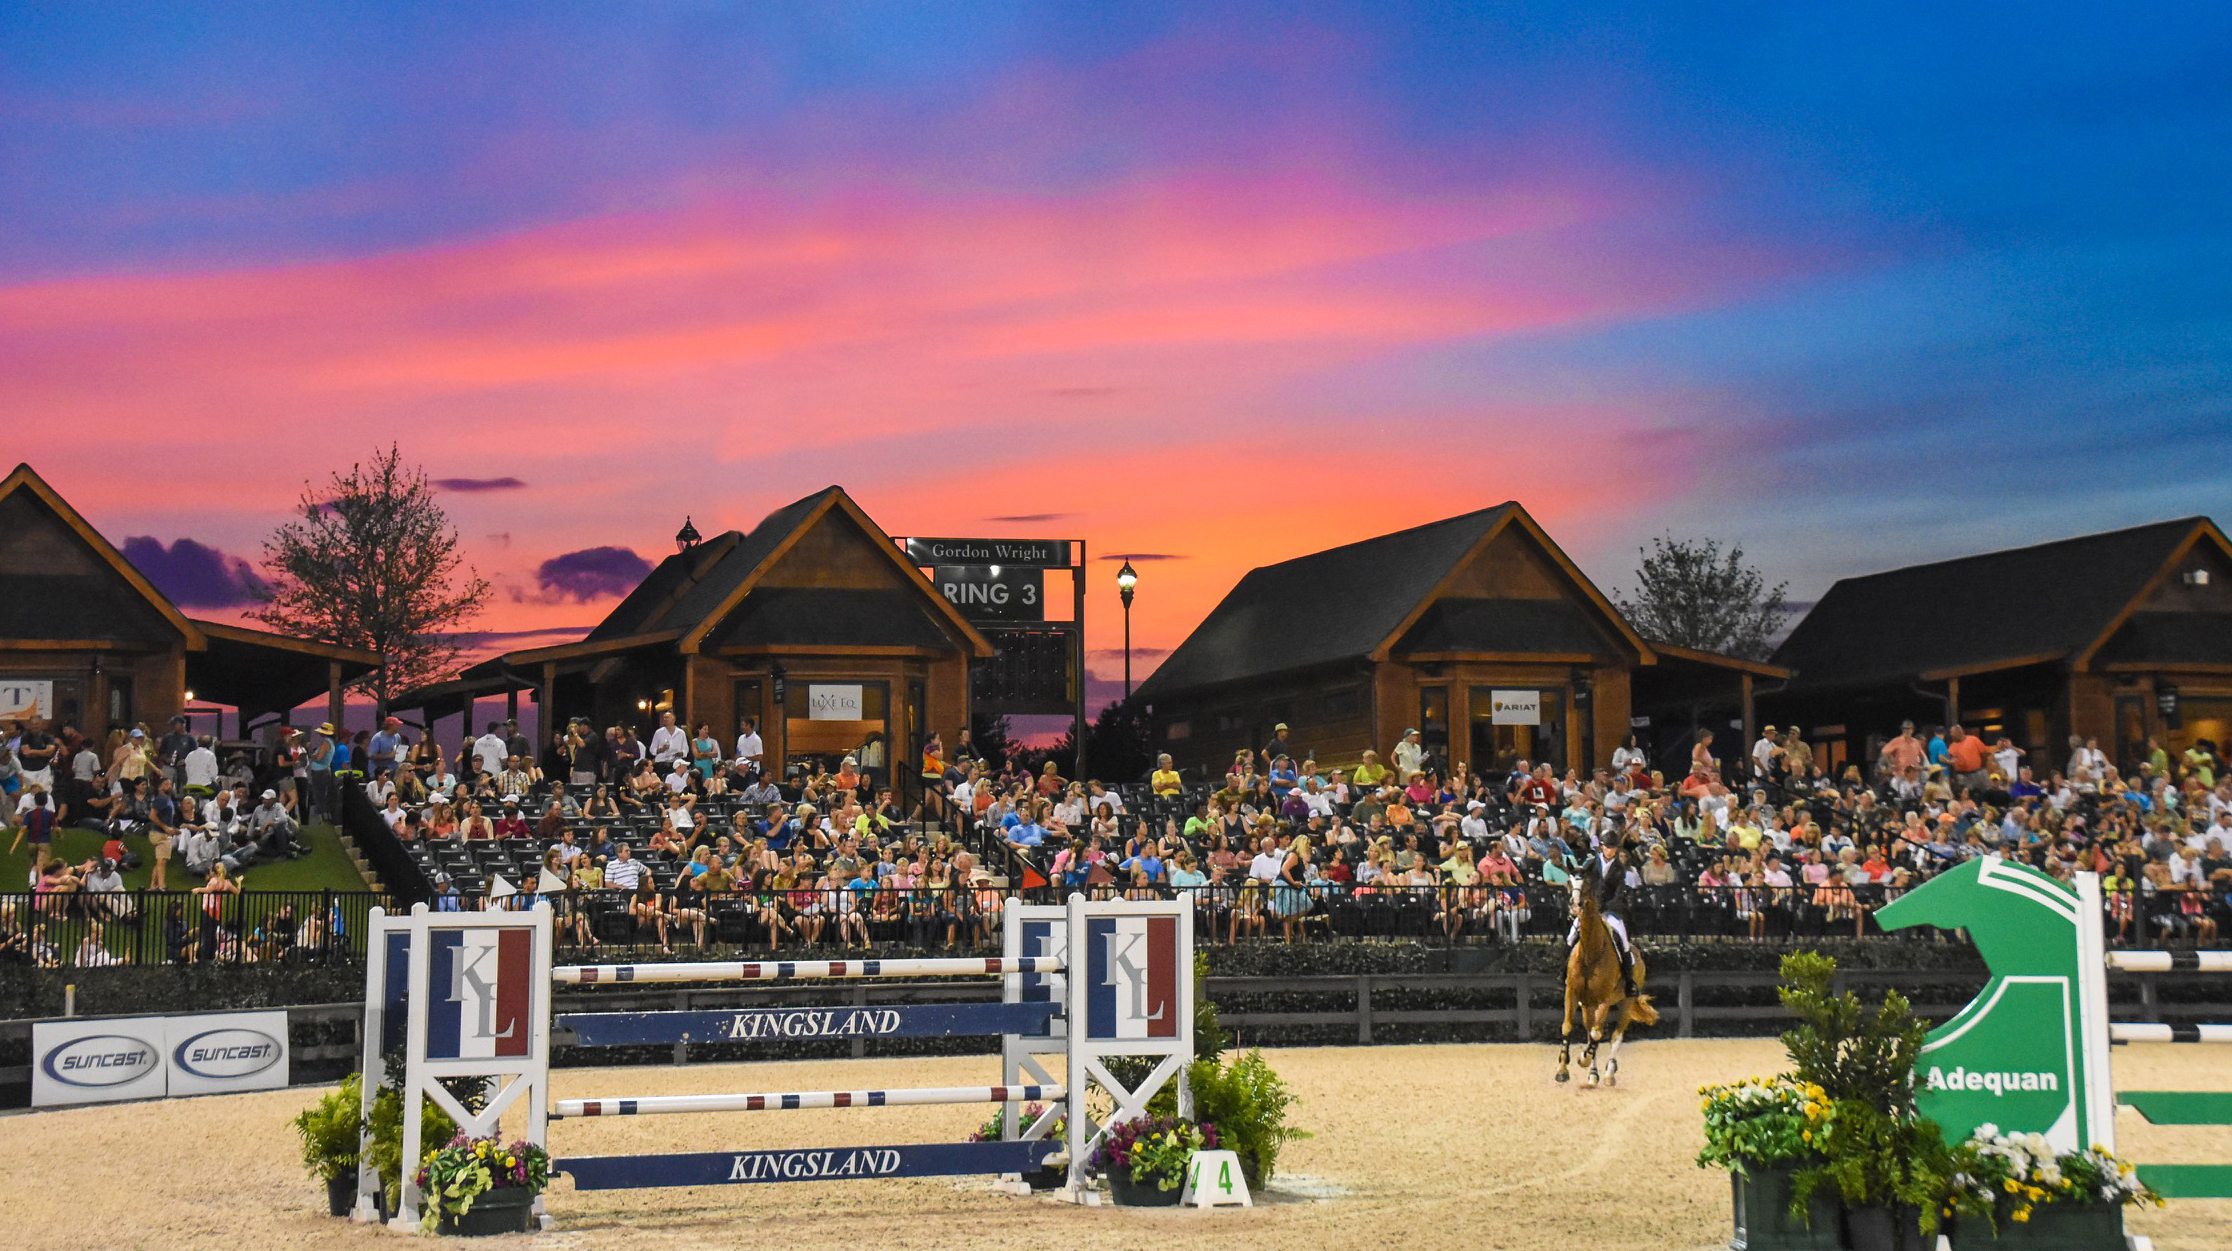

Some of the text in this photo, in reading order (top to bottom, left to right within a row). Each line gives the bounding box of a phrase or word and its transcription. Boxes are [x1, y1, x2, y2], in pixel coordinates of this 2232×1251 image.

[932, 543, 1047, 561] Gordon Wright
[943, 583, 1037, 605] RING 3
[729, 1010, 900, 1038] KINGSLAND
[1926, 1066, 2058, 1096] Adequan
[728, 1149, 901, 1180] KINGSLAND
[1218, 1160, 1233, 1195] 4
